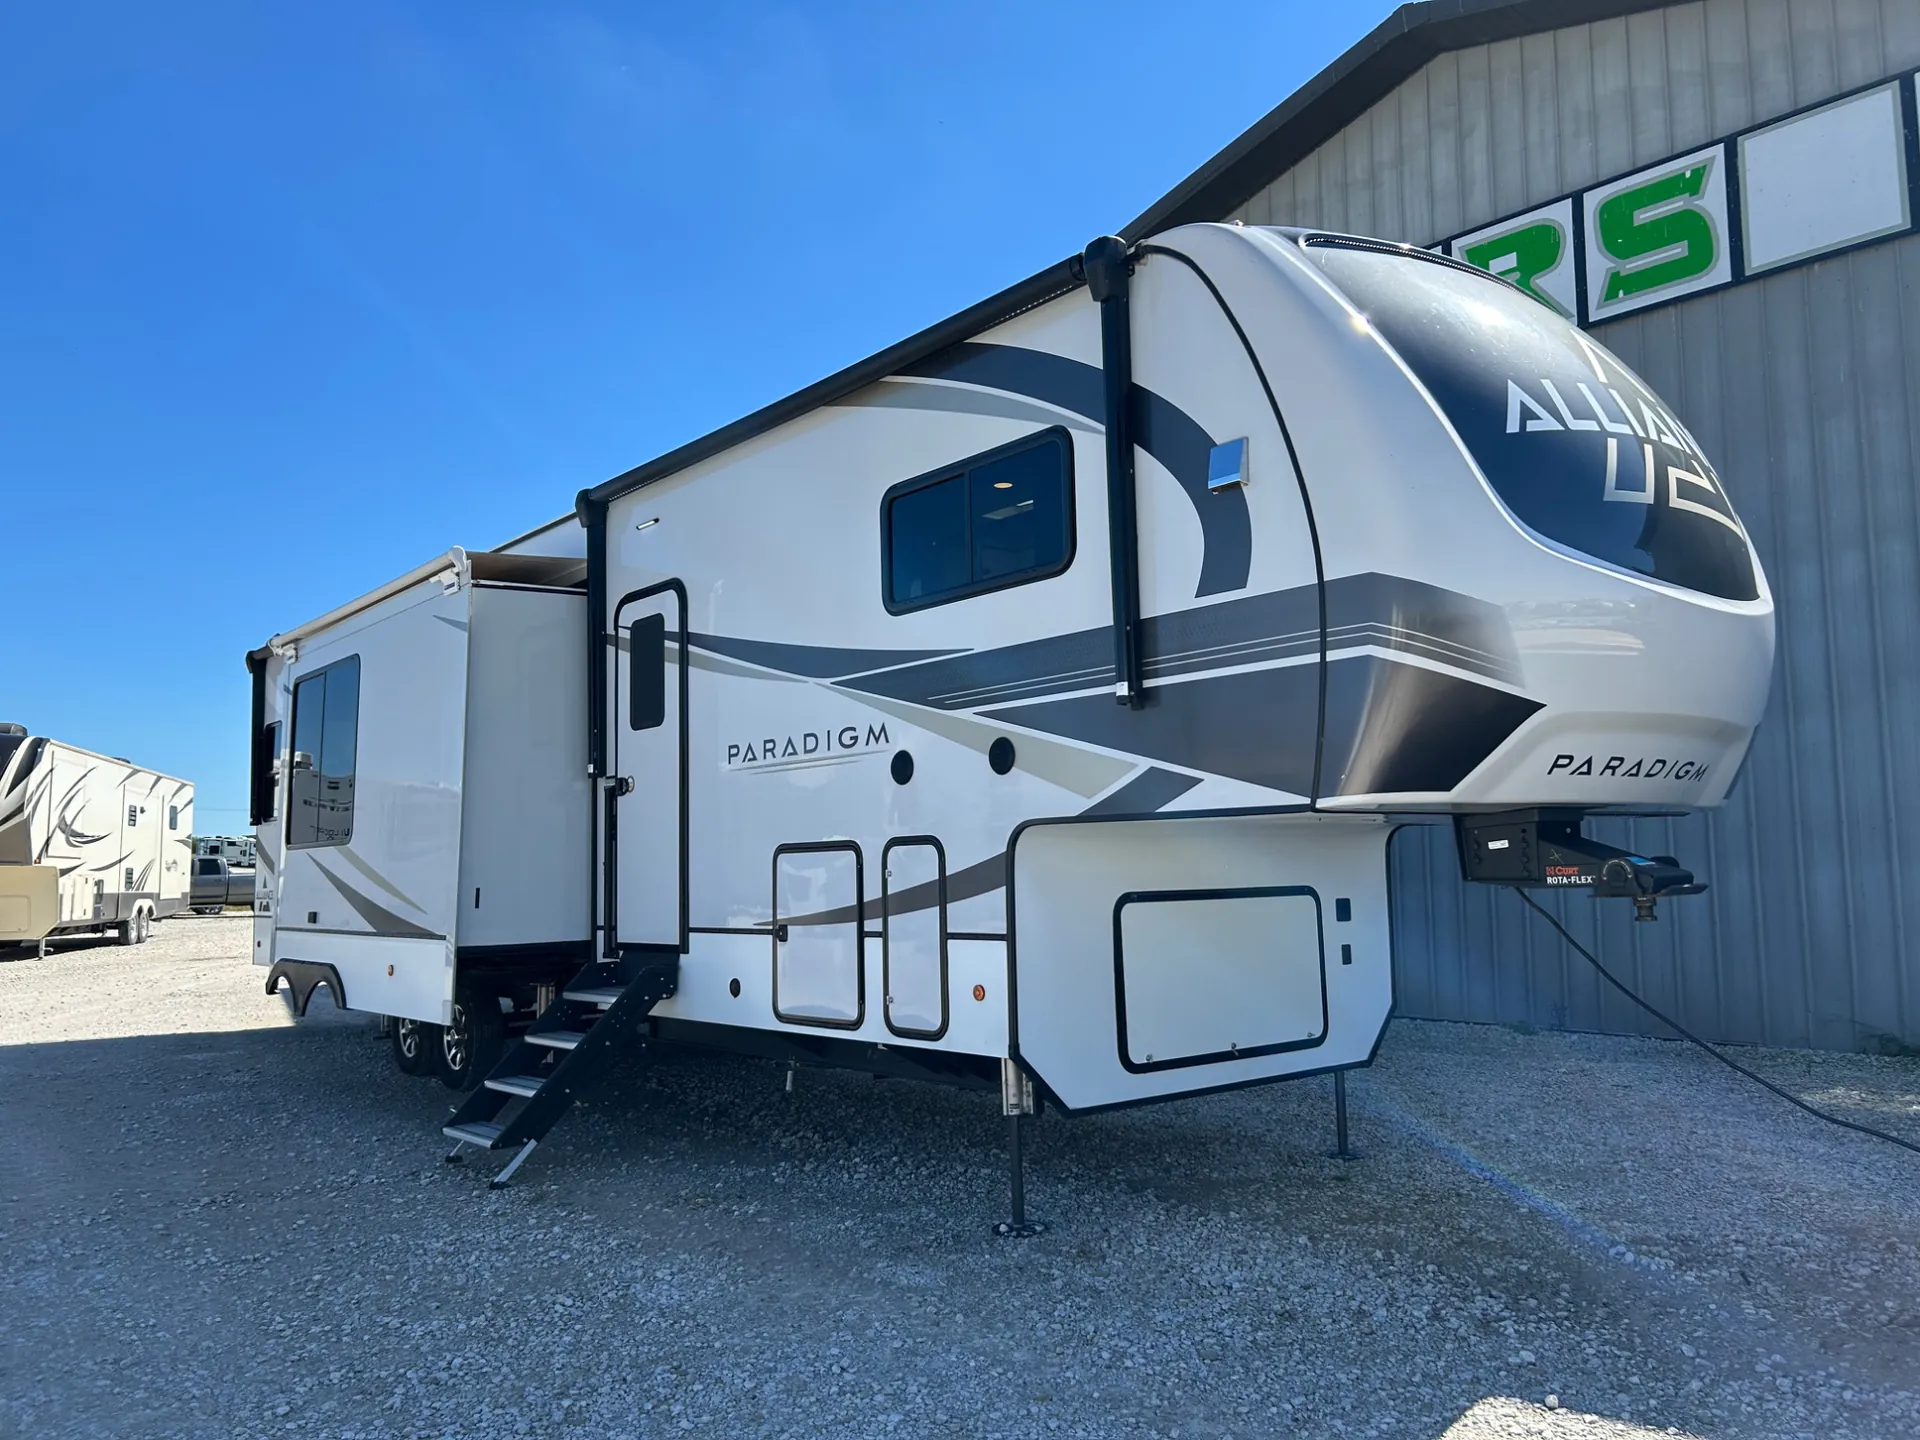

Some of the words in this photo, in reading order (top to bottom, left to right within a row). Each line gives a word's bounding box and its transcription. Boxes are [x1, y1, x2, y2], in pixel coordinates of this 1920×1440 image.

[1506, 379, 1709, 467] ALLIAN
[728, 722, 890, 765] PARADIGM
[1547, 754, 1710, 782] PARADIGM
